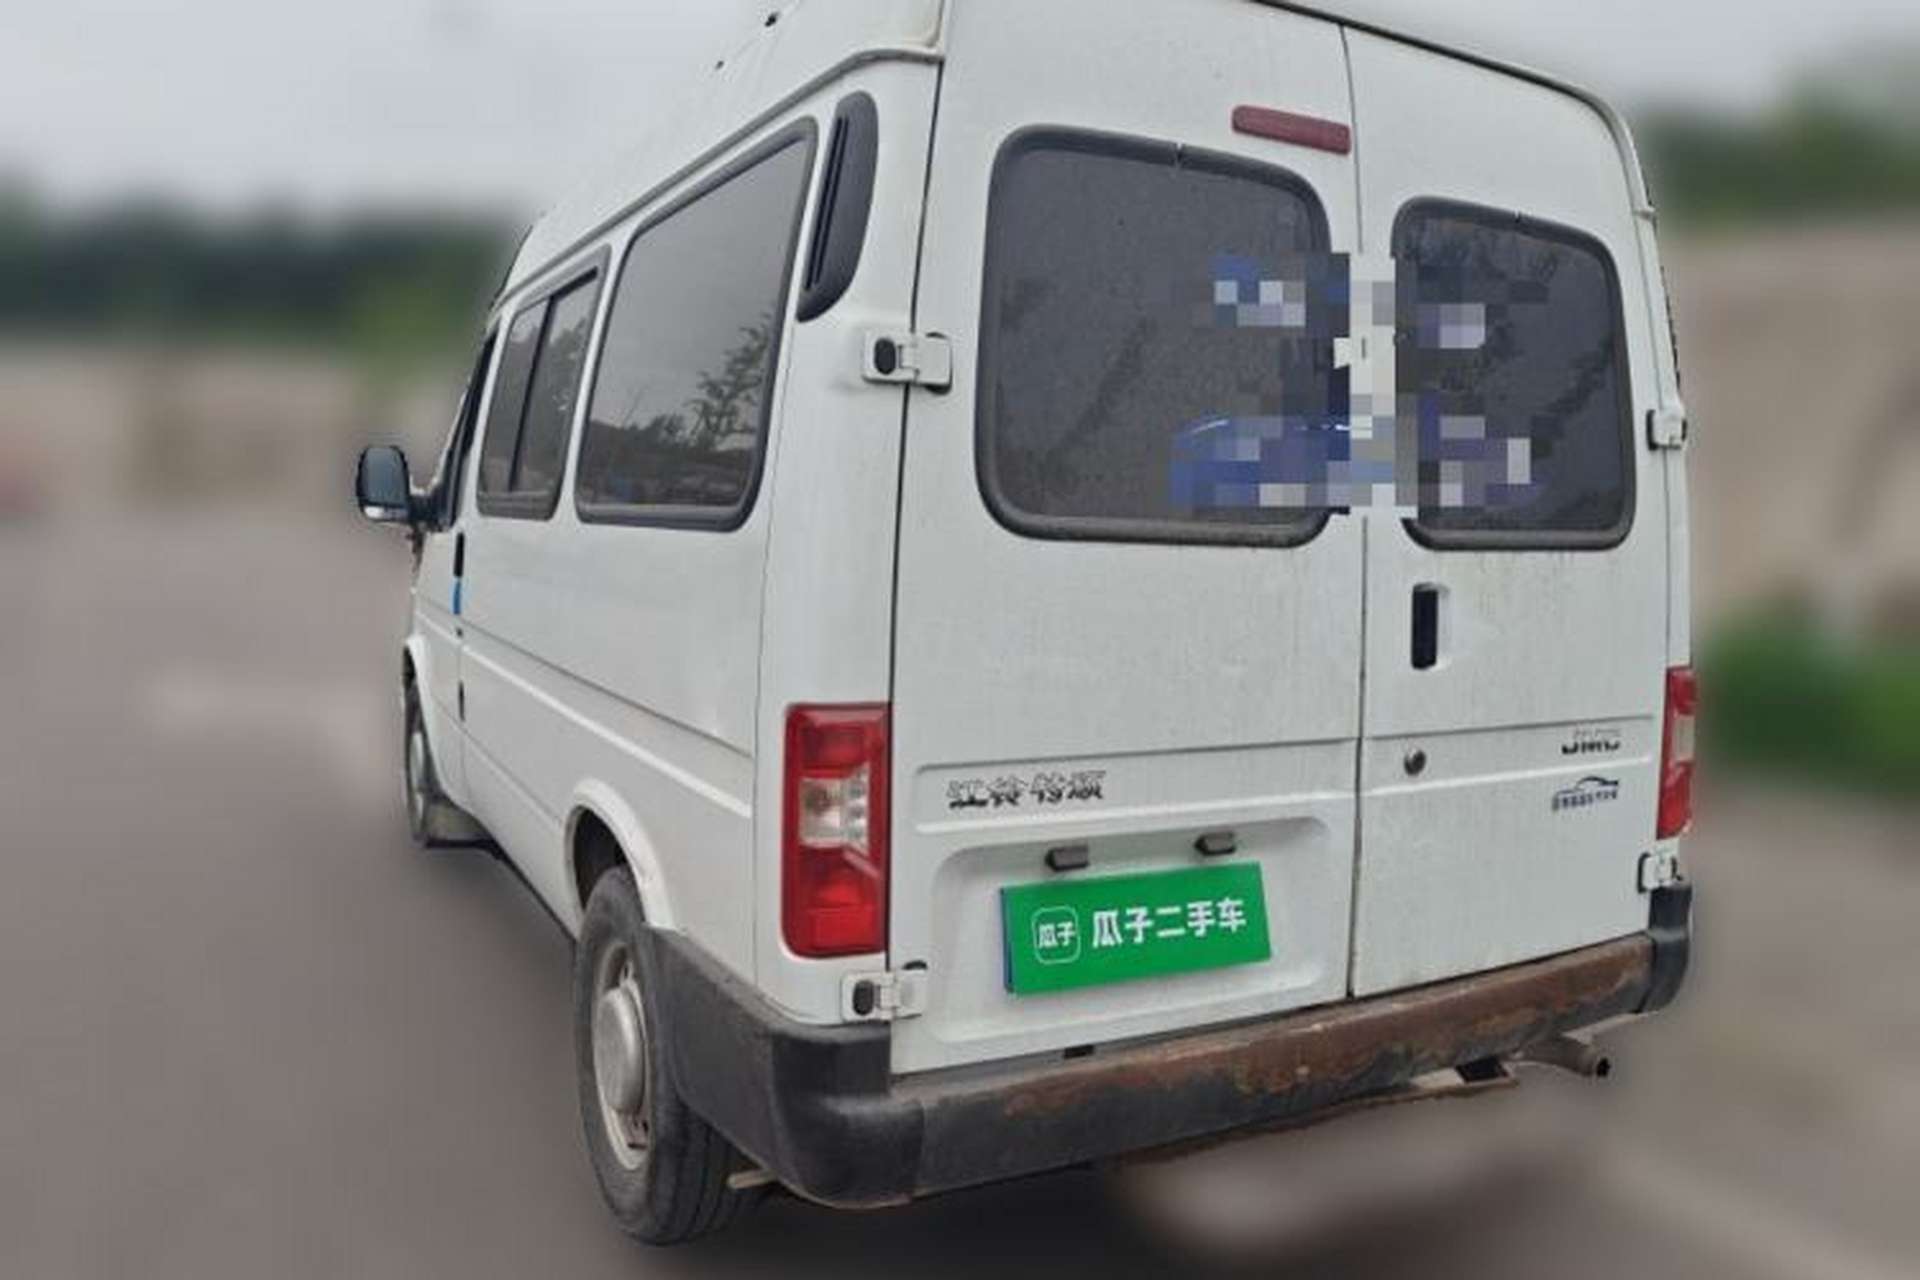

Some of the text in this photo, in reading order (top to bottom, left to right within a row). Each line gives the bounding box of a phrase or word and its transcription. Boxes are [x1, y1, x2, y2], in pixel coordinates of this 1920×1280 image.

[1036, 922, 1077, 950] 瓜子
[1091, 896, 1248, 949] 瓜子二手车
